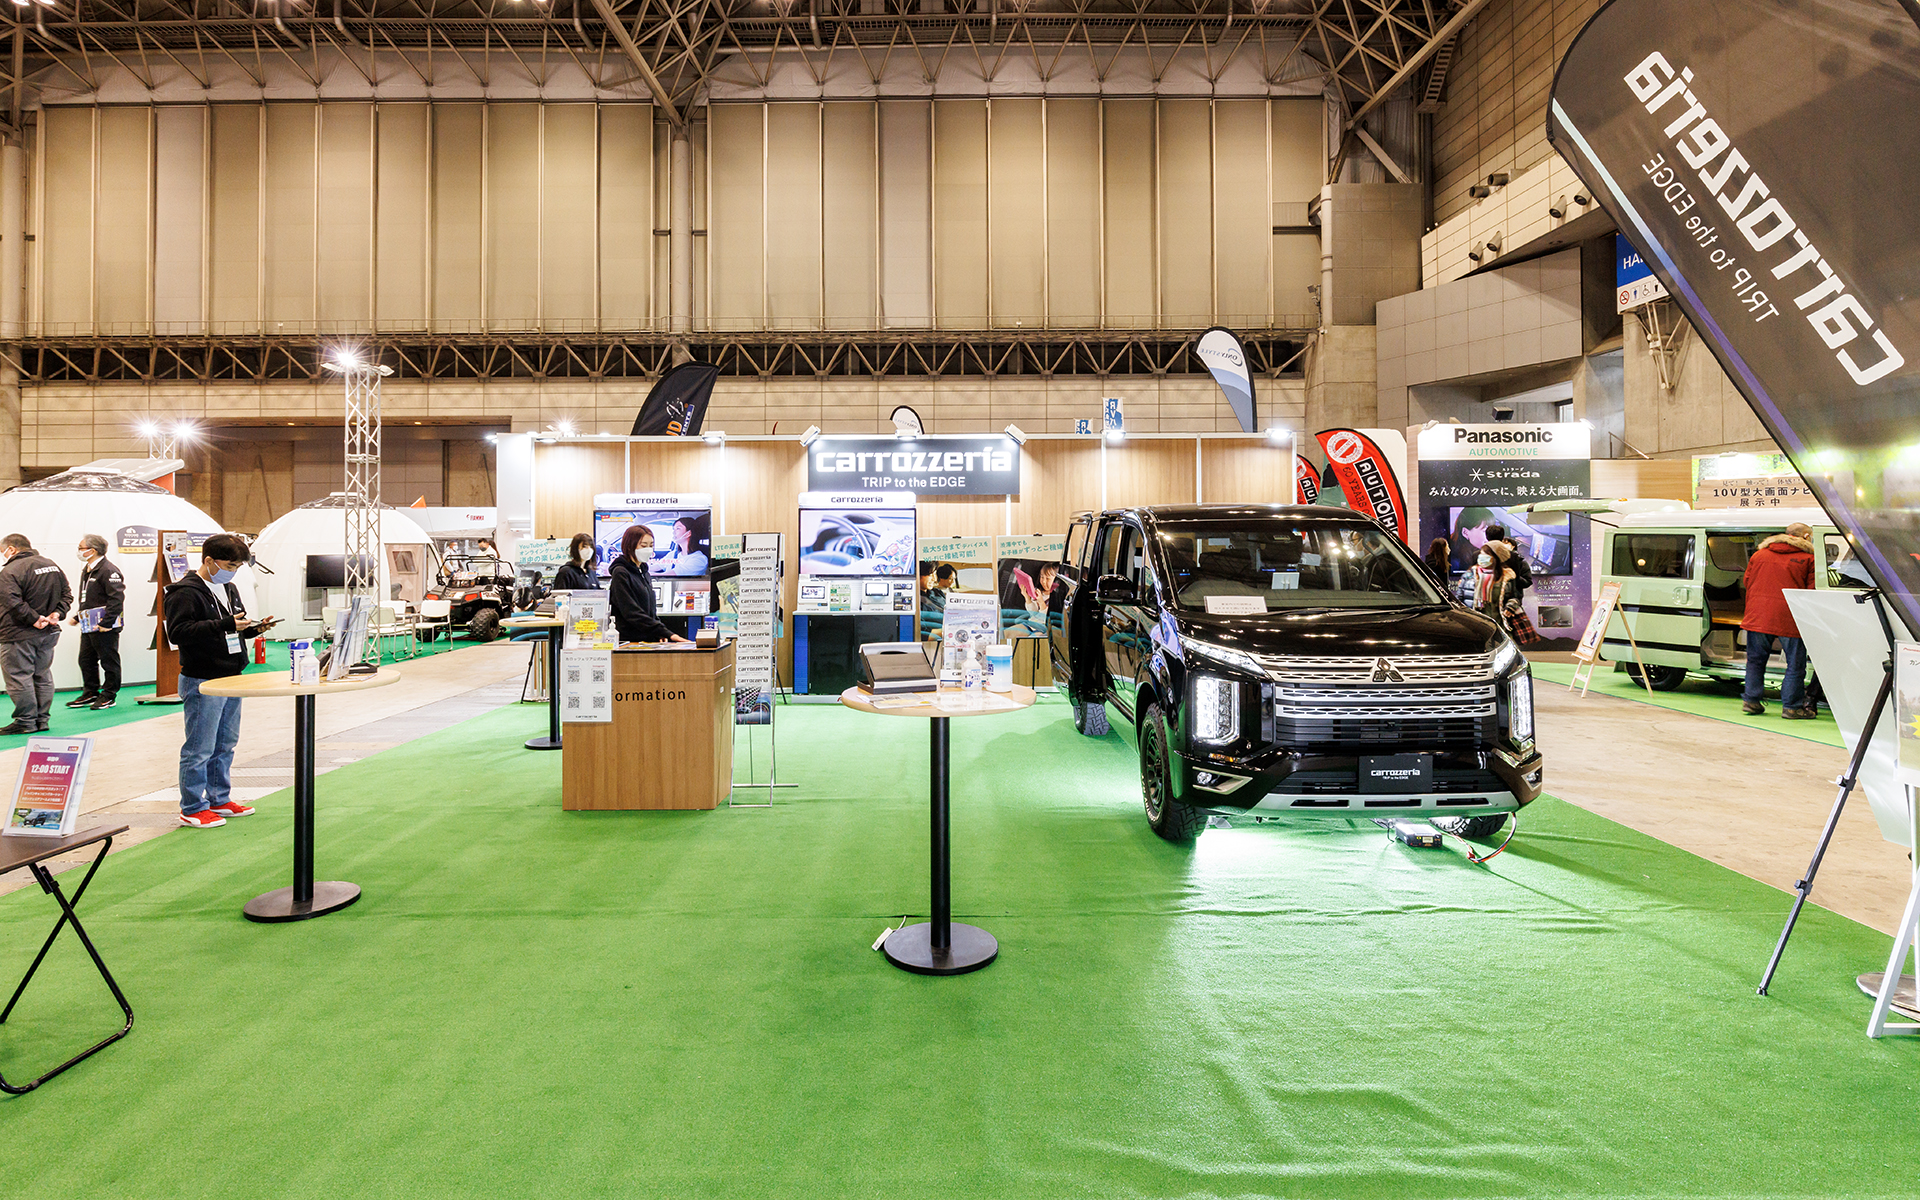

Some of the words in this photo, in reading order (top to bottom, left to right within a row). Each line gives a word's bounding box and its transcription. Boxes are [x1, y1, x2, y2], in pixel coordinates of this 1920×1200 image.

[1454, 428, 1553, 443] Panasonic
[1469, 448, 1538, 456] AUTOMOTIVE
[815, 447, 1012, 472] carrozzeria
[862, 477, 892, 488] TRIP
[894, 478, 906, 488] to
[908, 477, 927, 488] the
[930, 477, 966, 488] EDGE
[1349, 478, 1367, 508] YEARS
[1429, 486, 1584, 497] みんなのクルマに、映える大画面。
[949, 597, 994, 605] carrozzeria
[615, 689, 686, 702] ormation
[31, 764, 49, 773] 12:00
[49, 765, 70, 774] START
